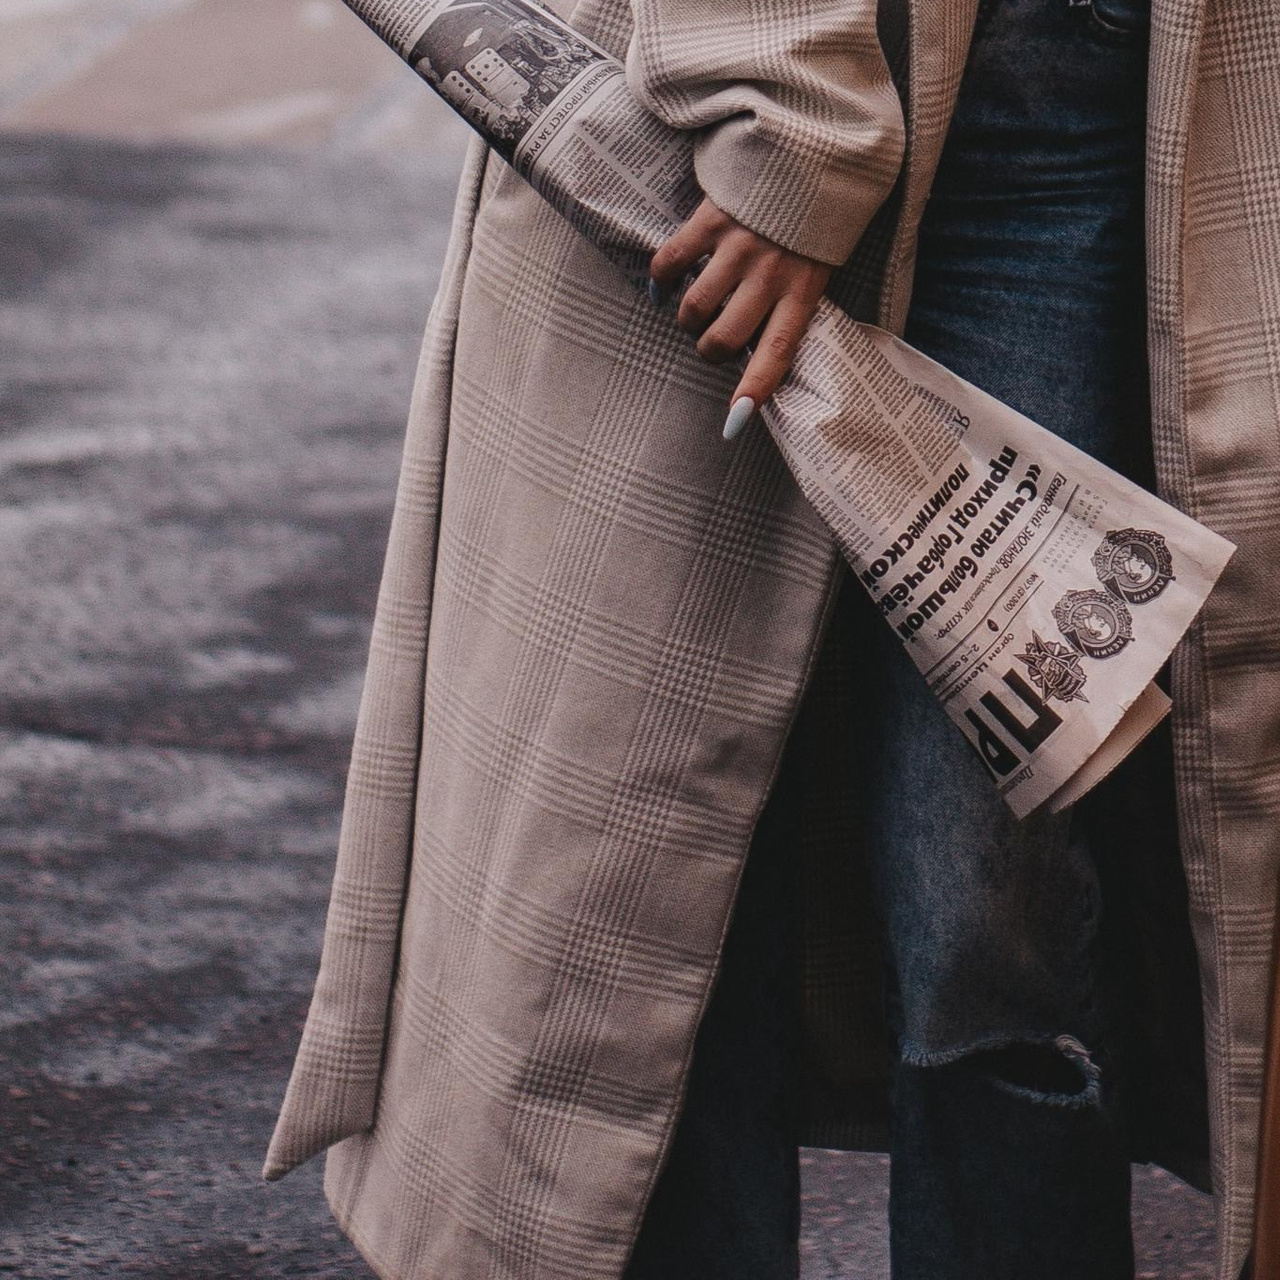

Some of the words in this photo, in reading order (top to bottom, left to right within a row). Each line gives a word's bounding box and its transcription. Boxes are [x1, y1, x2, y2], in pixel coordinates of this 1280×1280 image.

[547, 91, 583, 129] ПРОТЕСТ
[537, 126, 551, 141] ЗА
[948, 444, 1018, 528] приход
[1028, 471, 1067, 528] Геннадий
[857, 462, 970, 592] политической
[968, 464, 1040, 558] «Считаю
[995, 524, 1035, 569] ЗЮГАНОВ,
[895, 555, 976, 643] большой
[1002, 585, 1026, 613] (31300)
[1132, 577, 1164, 603] ЛЕНИН
[932, 610, 964, 640] КПРФ:
[986, 631, 1015, 662] Орган
[1092, 637, 1124, 658] ЛЕНИН
[959, 667, 1063, 783] ПР
